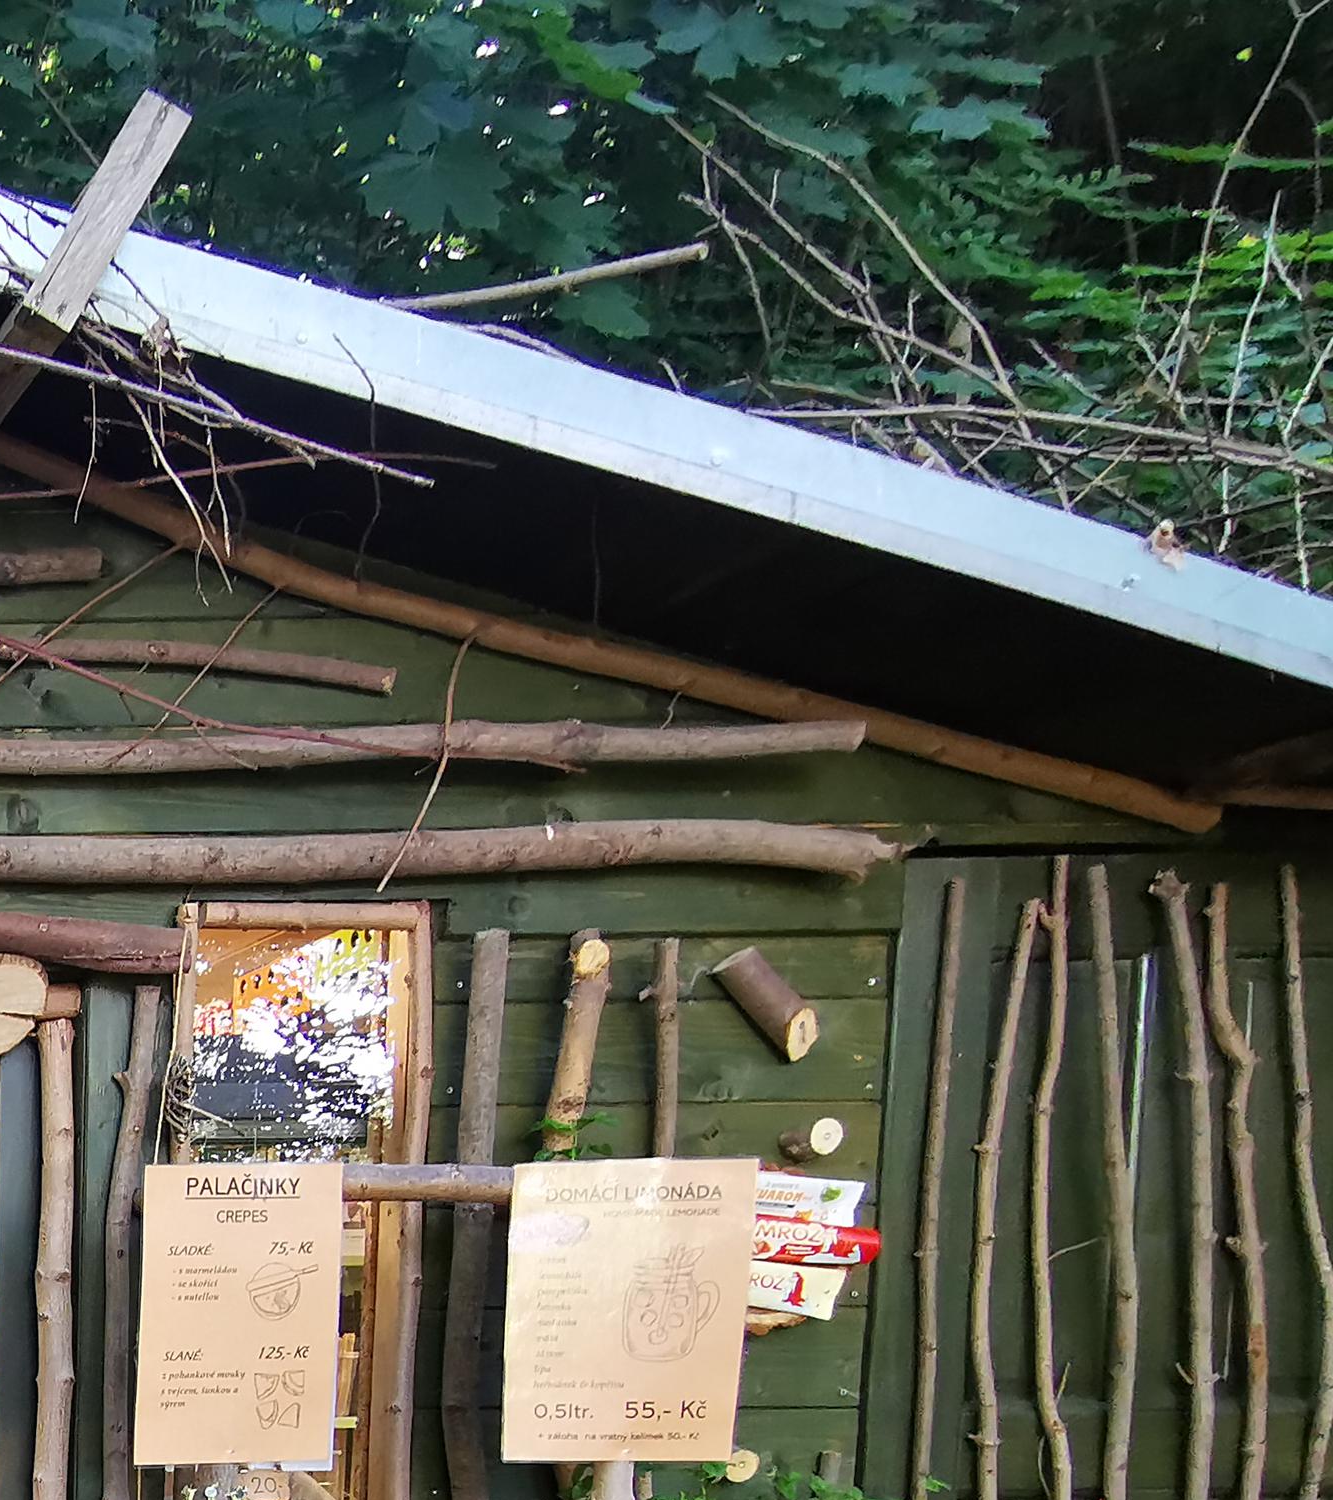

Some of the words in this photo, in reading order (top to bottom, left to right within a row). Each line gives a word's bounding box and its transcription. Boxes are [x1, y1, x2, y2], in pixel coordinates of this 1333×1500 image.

[186, 1173, 301, 1197] PALAČINKY
[216, 1209, 269, 1224] CREPES
[680, 1400, 707, 1419] Kč
